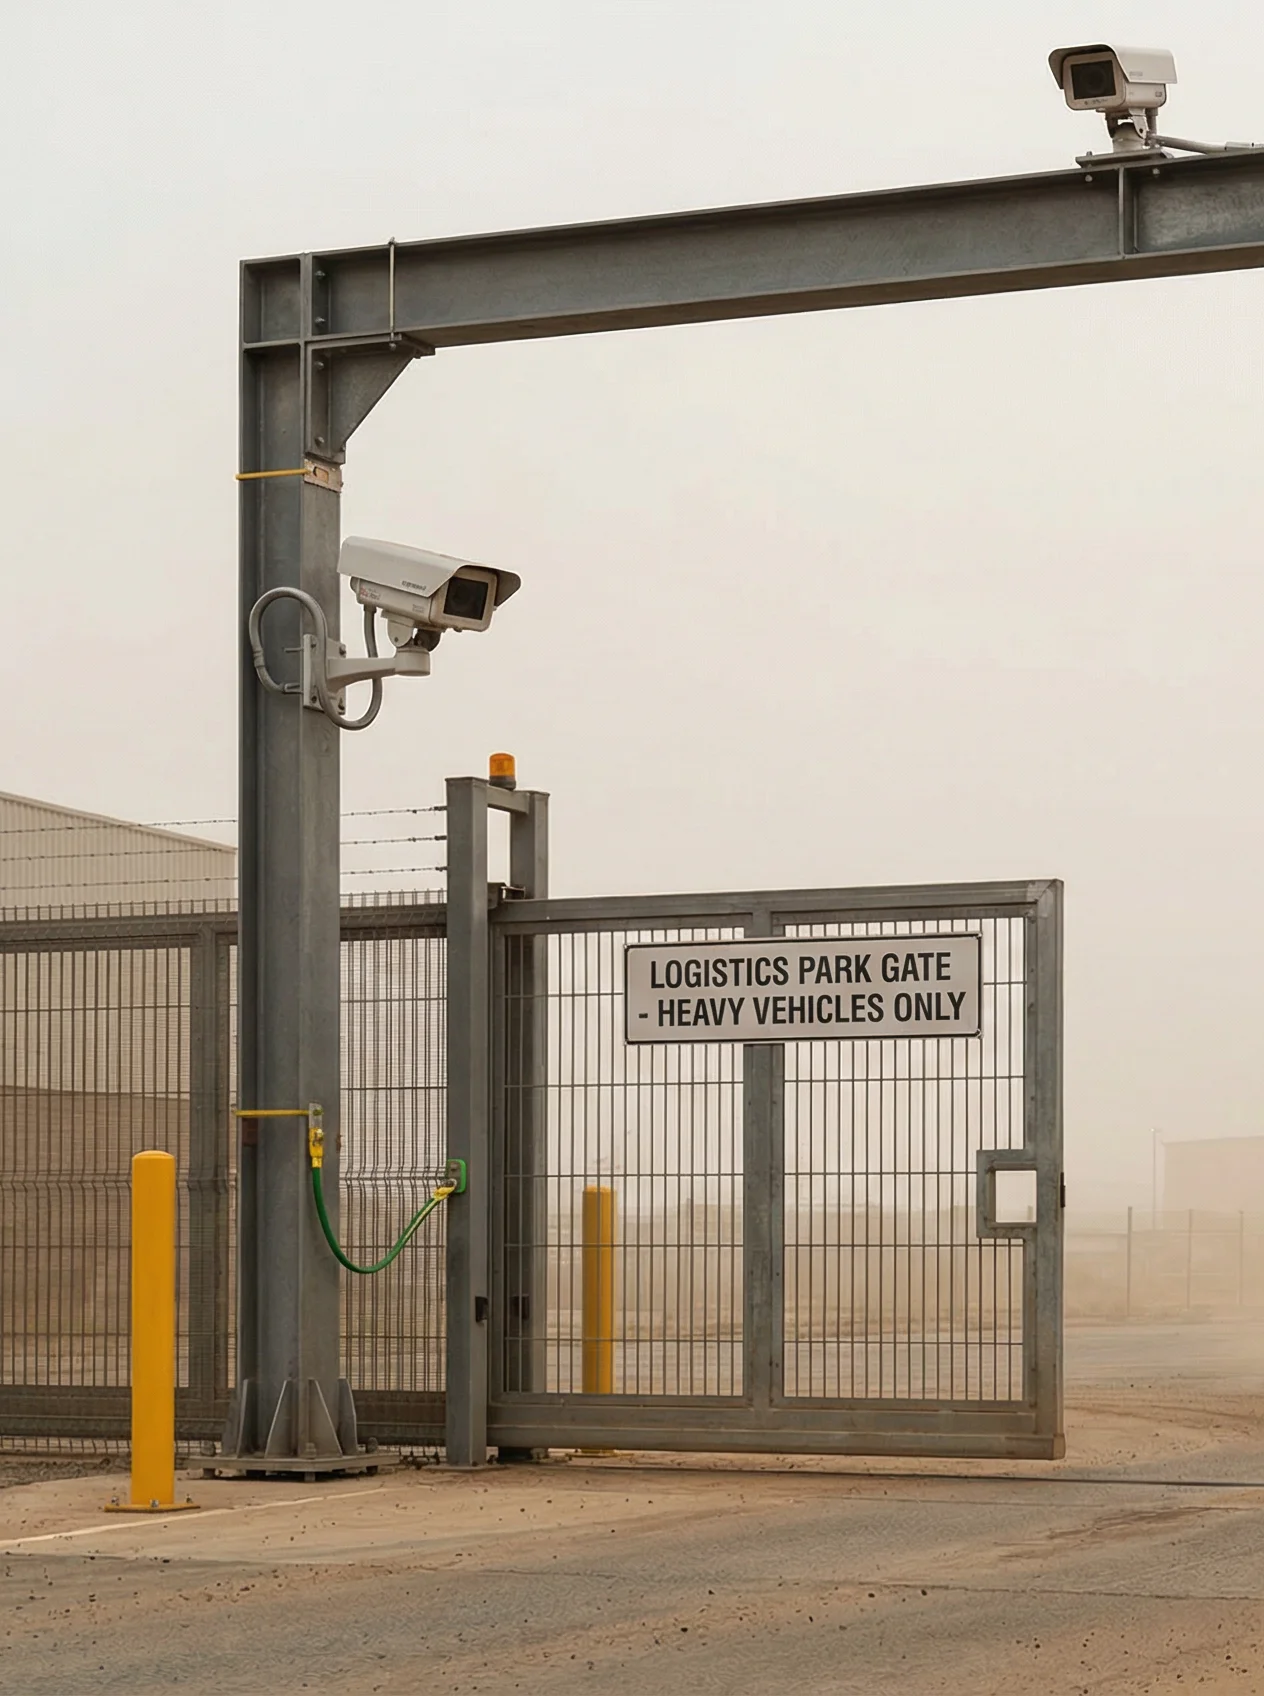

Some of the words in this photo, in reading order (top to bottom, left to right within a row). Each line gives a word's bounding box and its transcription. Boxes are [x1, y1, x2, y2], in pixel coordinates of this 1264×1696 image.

[650, 956, 789, 989] LOGISTICS
[799, 953, 872, 985] PARK
[881, 952, 951, 983] GATE
[658, 997, 746, 1027] HEAVY
[753, 993, 884, 1025] VEHICLES
[894, 991, 967, 1022] ONLY
